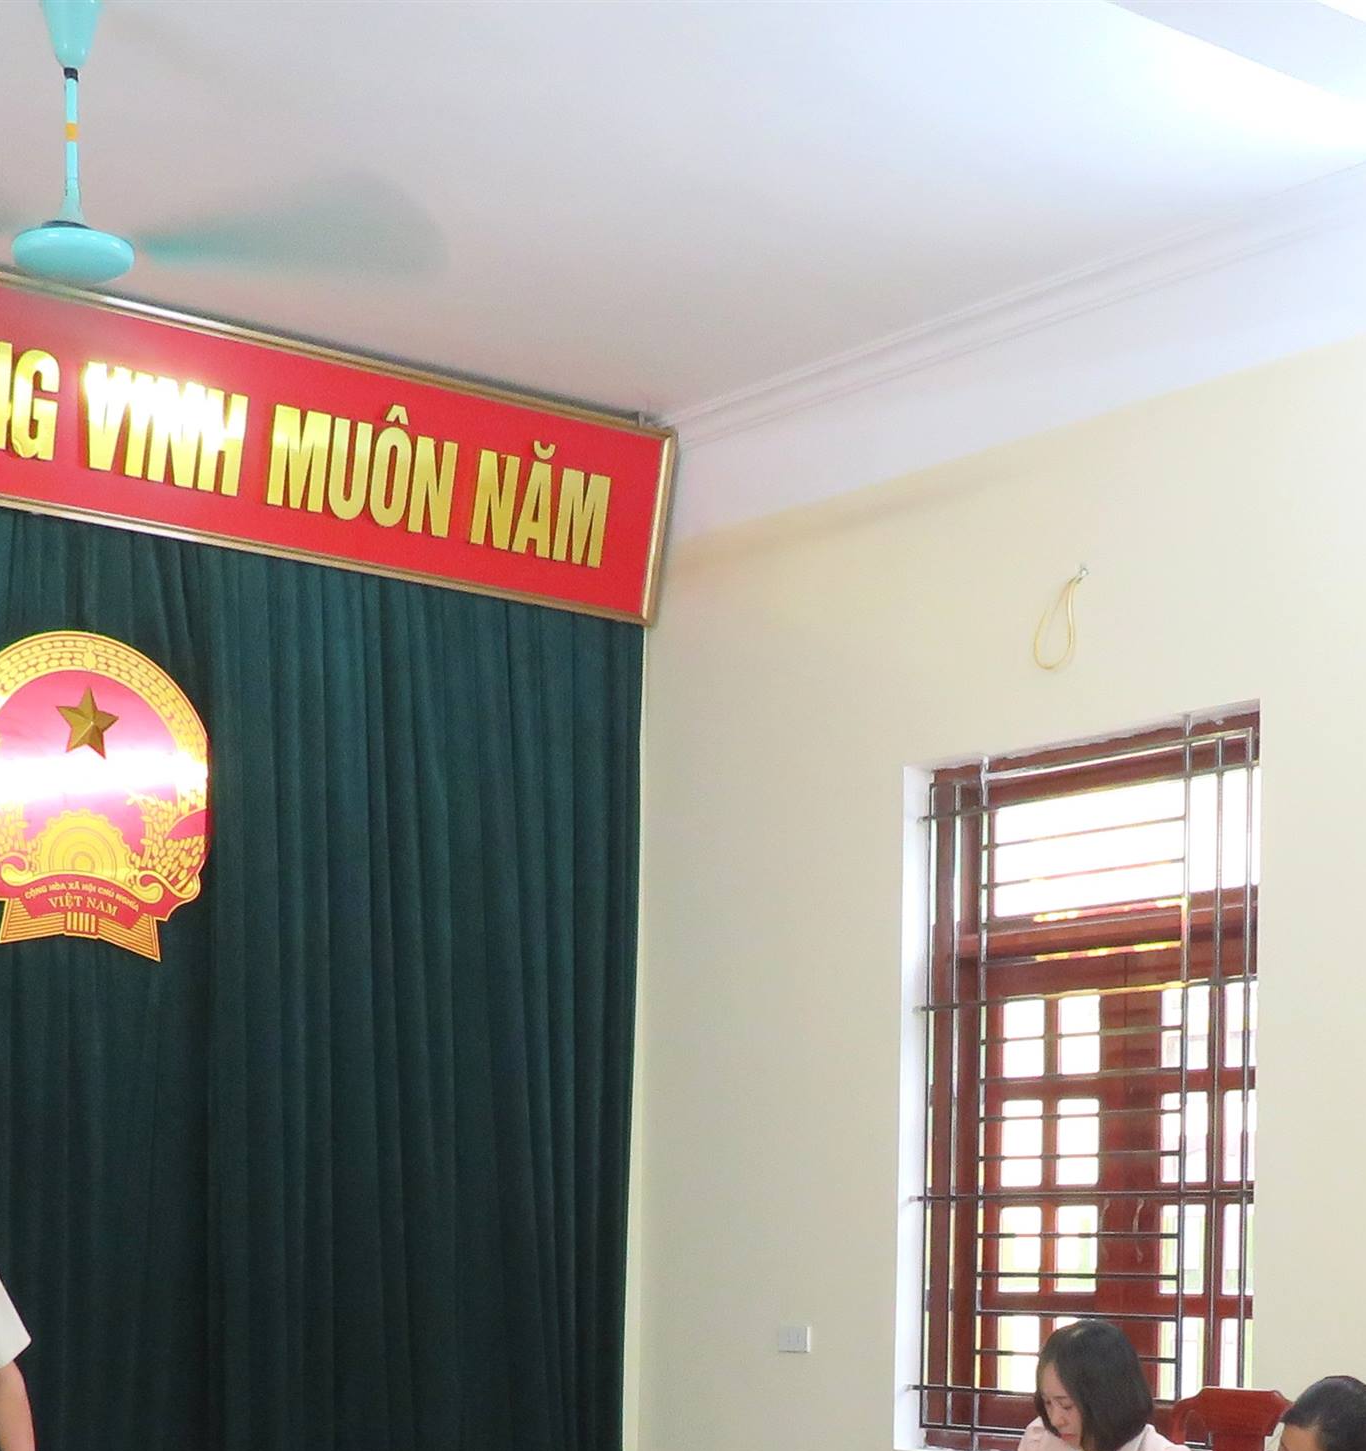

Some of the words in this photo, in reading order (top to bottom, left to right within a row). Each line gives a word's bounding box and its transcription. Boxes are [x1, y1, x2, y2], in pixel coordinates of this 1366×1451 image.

[83, 361, 248, 497] VINH
[266, 404, 458, 539] MUÔN
[469, 441, 612, 569] NĂM
[48, 891, 83, 910] VIỆT
[86, 896, 119, 916] NAM
